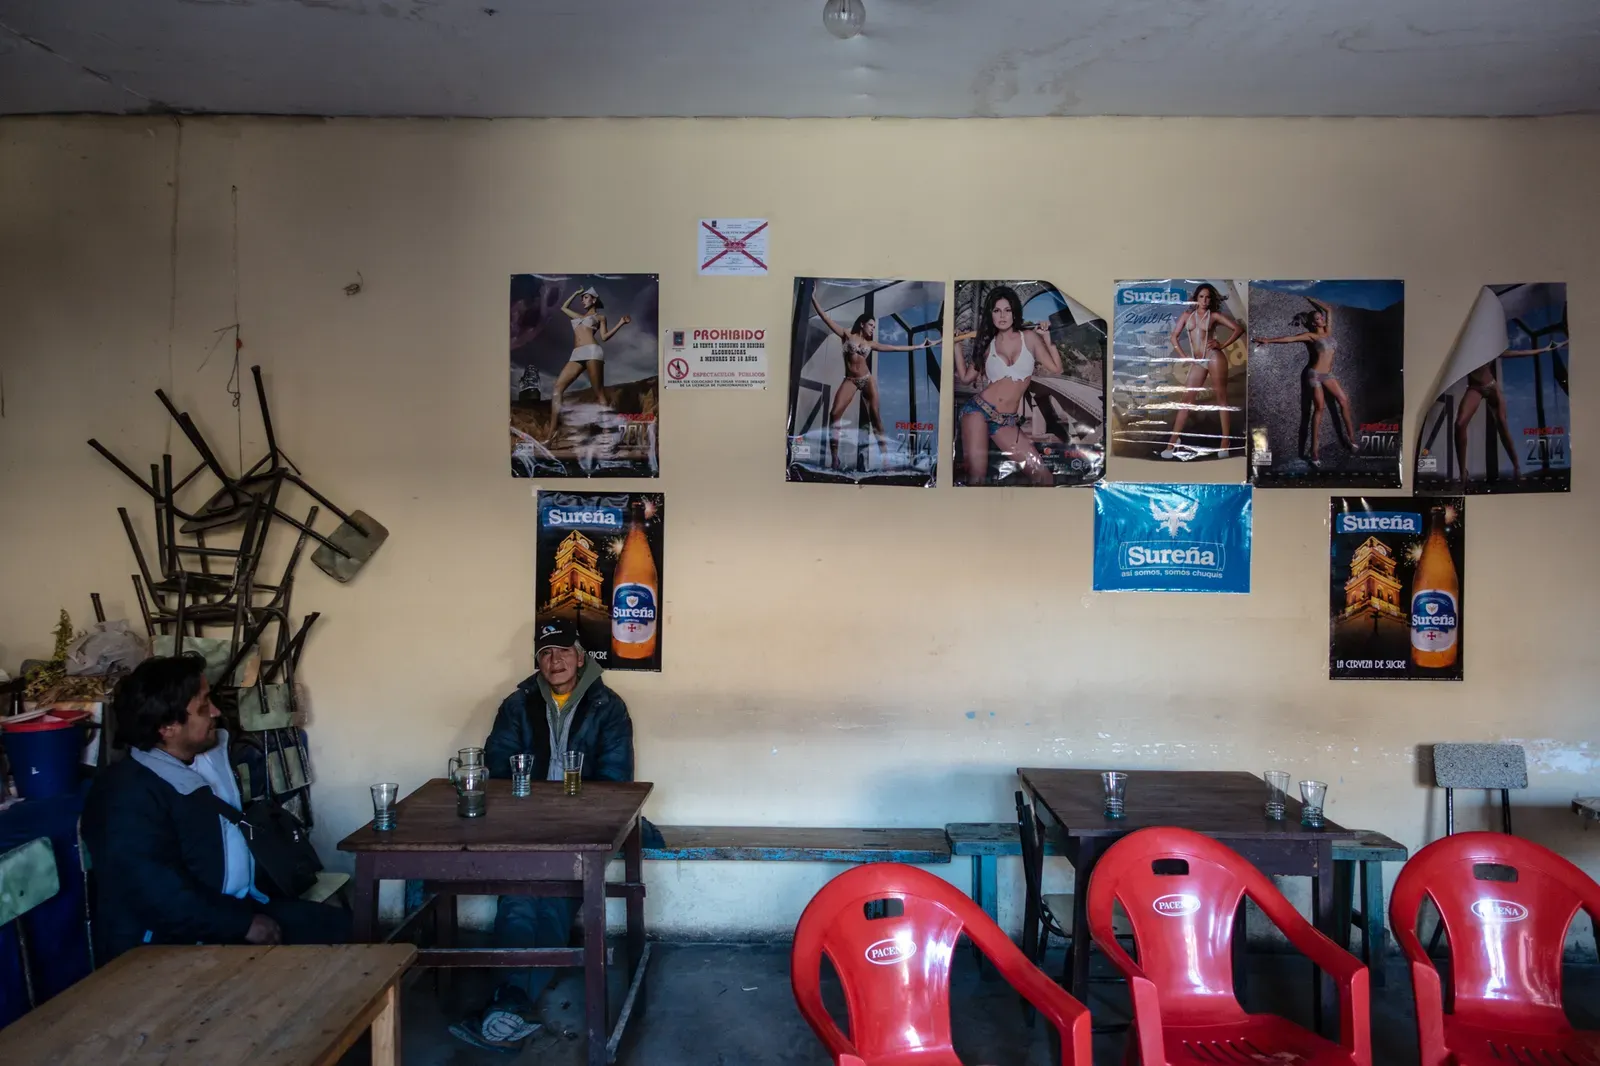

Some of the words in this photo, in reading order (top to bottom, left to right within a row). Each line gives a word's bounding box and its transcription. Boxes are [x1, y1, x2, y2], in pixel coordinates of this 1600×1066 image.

[1123, 289, 1180, 303] Sureña
[693, 329, 765, 340] PROHIBIDO
[897, 433, 932, 455] 2014
[1361, 436, 1396, 451] 2014
[1526, 439, 1564, 460] 2014
[548, 508, 616, 524] Sureña
[1342, 514, 1415, 531] Sureña
[1128, 546, 1216, 566] Sureña
[1192, 570, 1223, 578] chuquis
[613, 606, 654, 618] Sureña
[1412, 614, 1455, 626] Sureña
[1336, 660, 1344, 669] LA
[1346, 660, 1372, 669] CERVEZA
[1374, 660, 1384, 669] DE
[1386, 660, 1406, 669] SUCRE
